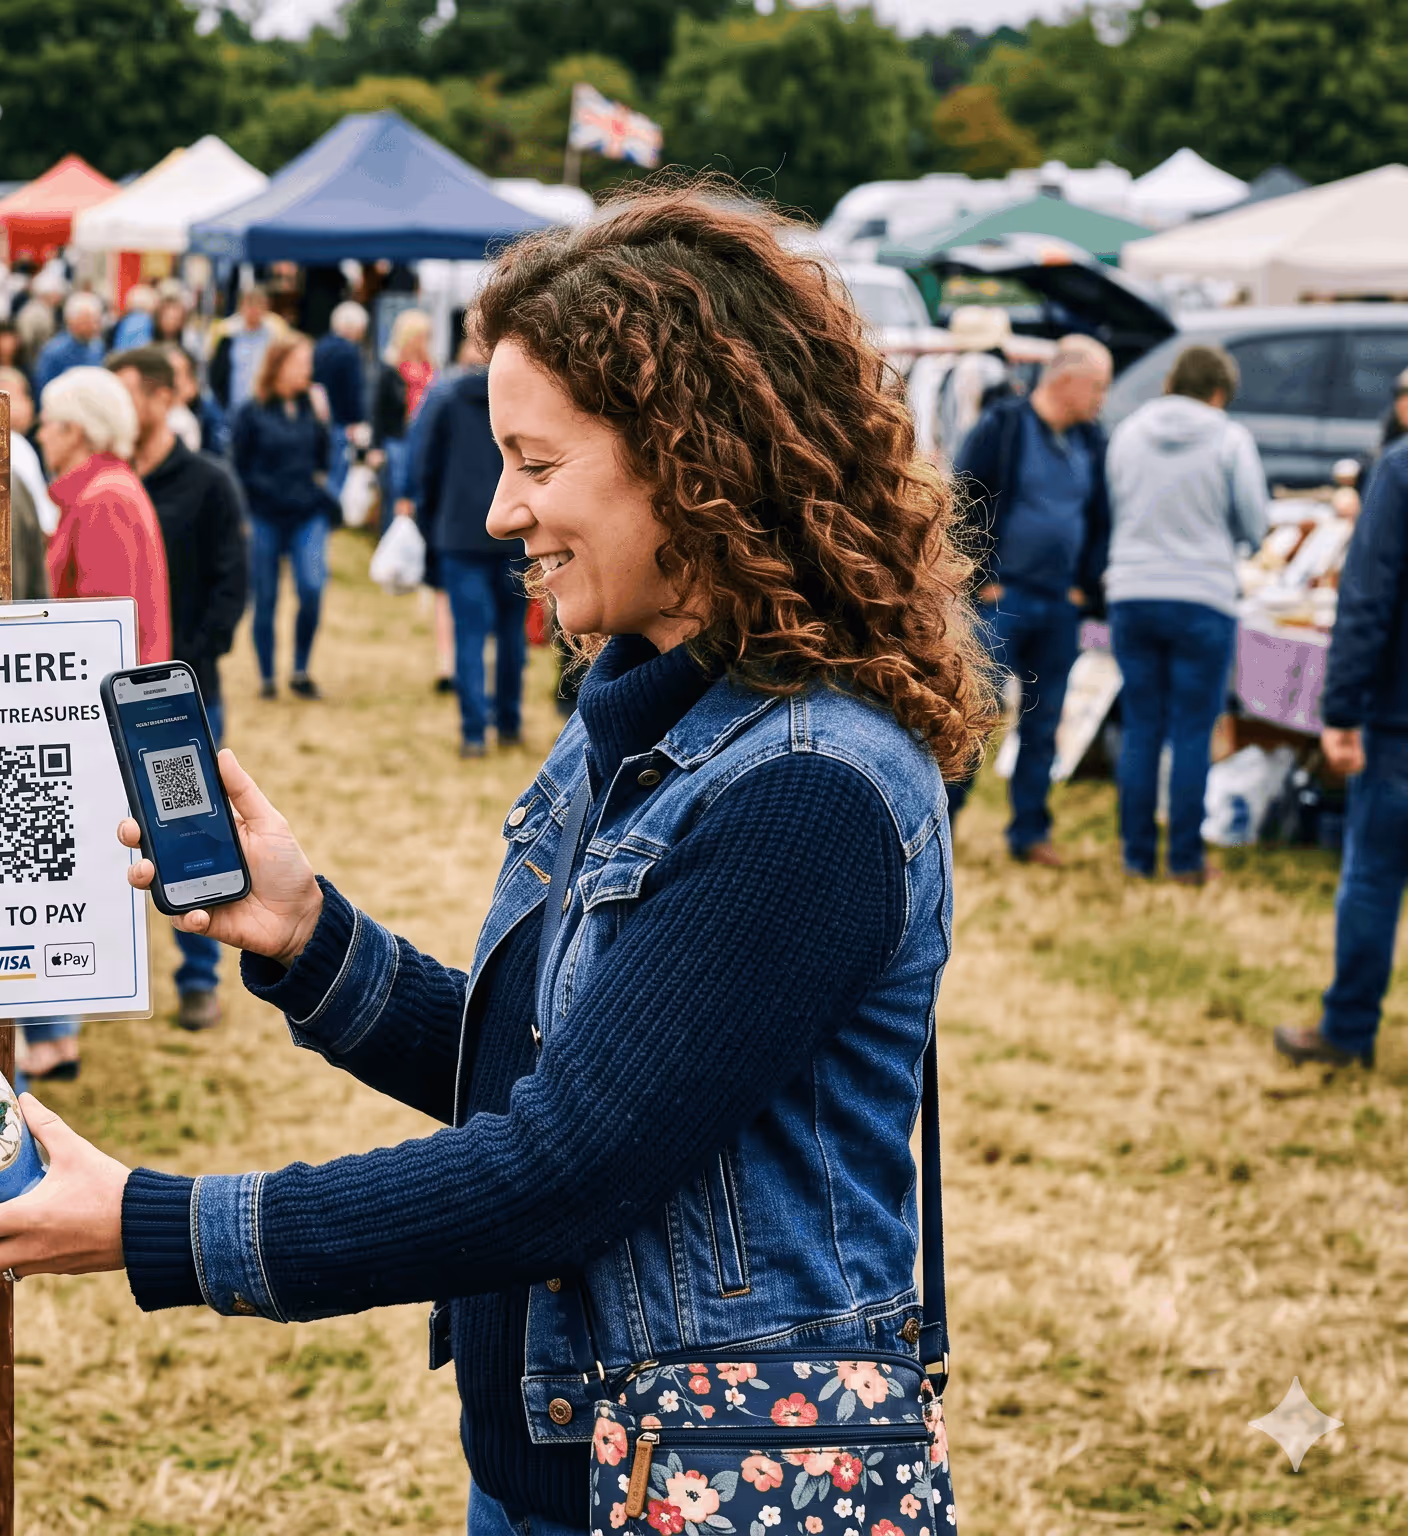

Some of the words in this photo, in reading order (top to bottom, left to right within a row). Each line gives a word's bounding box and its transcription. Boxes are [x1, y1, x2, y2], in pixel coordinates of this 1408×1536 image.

[4, 905, 37, 927] TO
[45, 902, 87, 924] PAY
[63, 952, 89, 968] Pay
